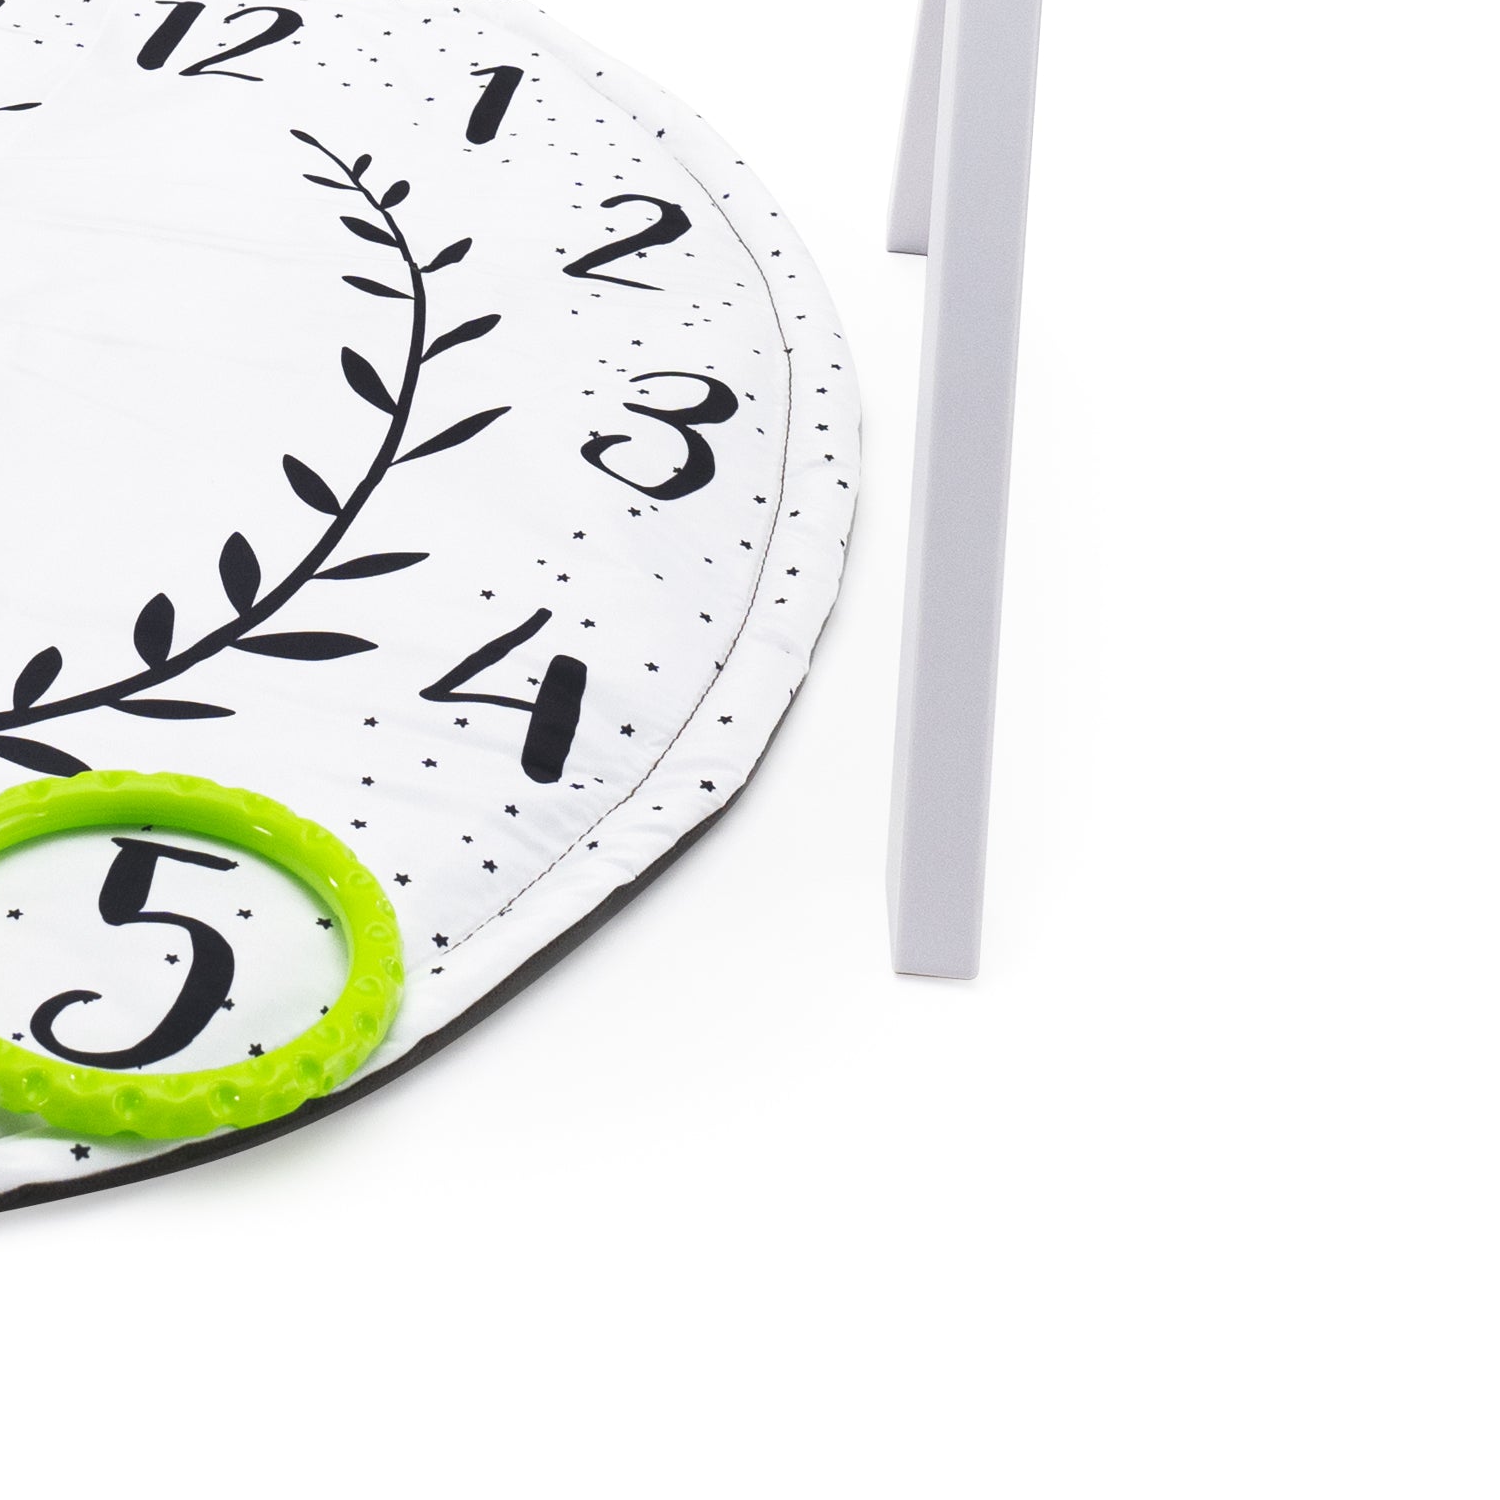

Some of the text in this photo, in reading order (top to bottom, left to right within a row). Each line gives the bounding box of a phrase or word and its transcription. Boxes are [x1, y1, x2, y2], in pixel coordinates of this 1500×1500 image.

[134, 0, 304, 82] 12
[465, 65, 525, 145] 1
[563, 194, 692, 291] 2
[581, 371, 739, 501] 3
[420, 607, 588, 784] 4
[30, 837, 240, 1070] 5
